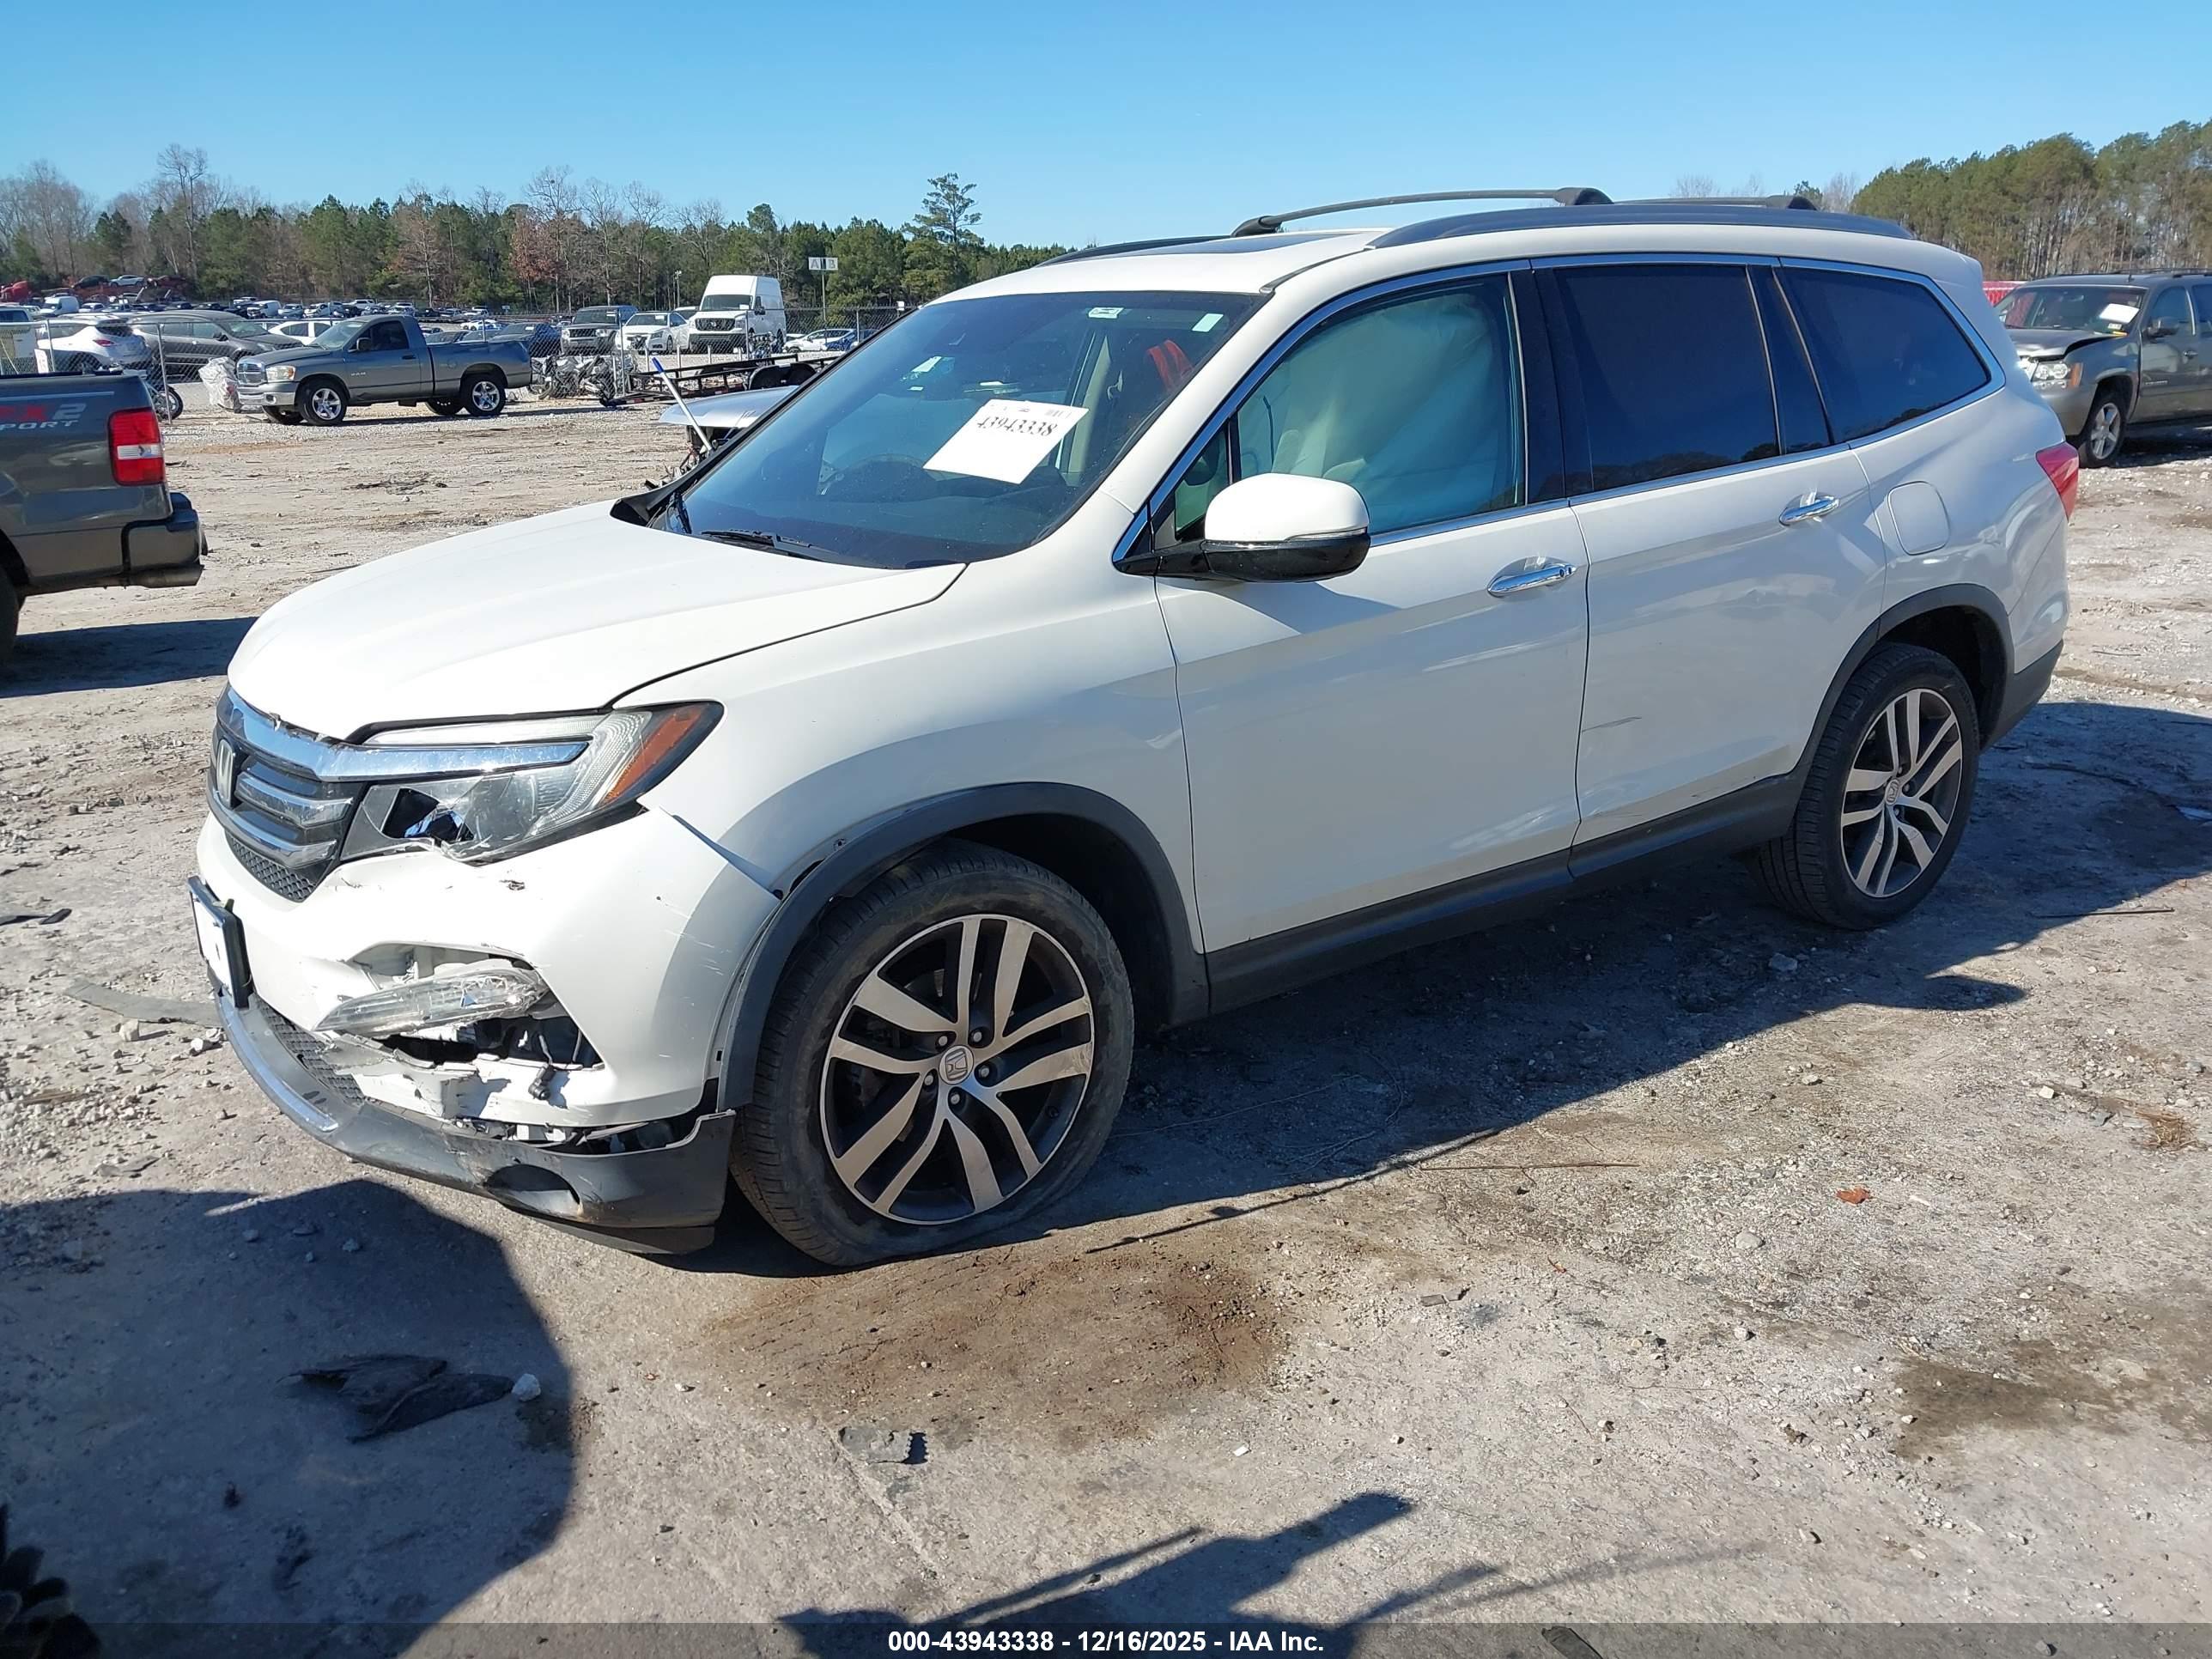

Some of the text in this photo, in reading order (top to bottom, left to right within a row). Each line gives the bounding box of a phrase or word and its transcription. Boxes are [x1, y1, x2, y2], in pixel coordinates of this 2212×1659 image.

[811, 258, 836, 269] A B
[0, 419, 79, 431] PORT
[976, 416, 1058, 436] 43943338
